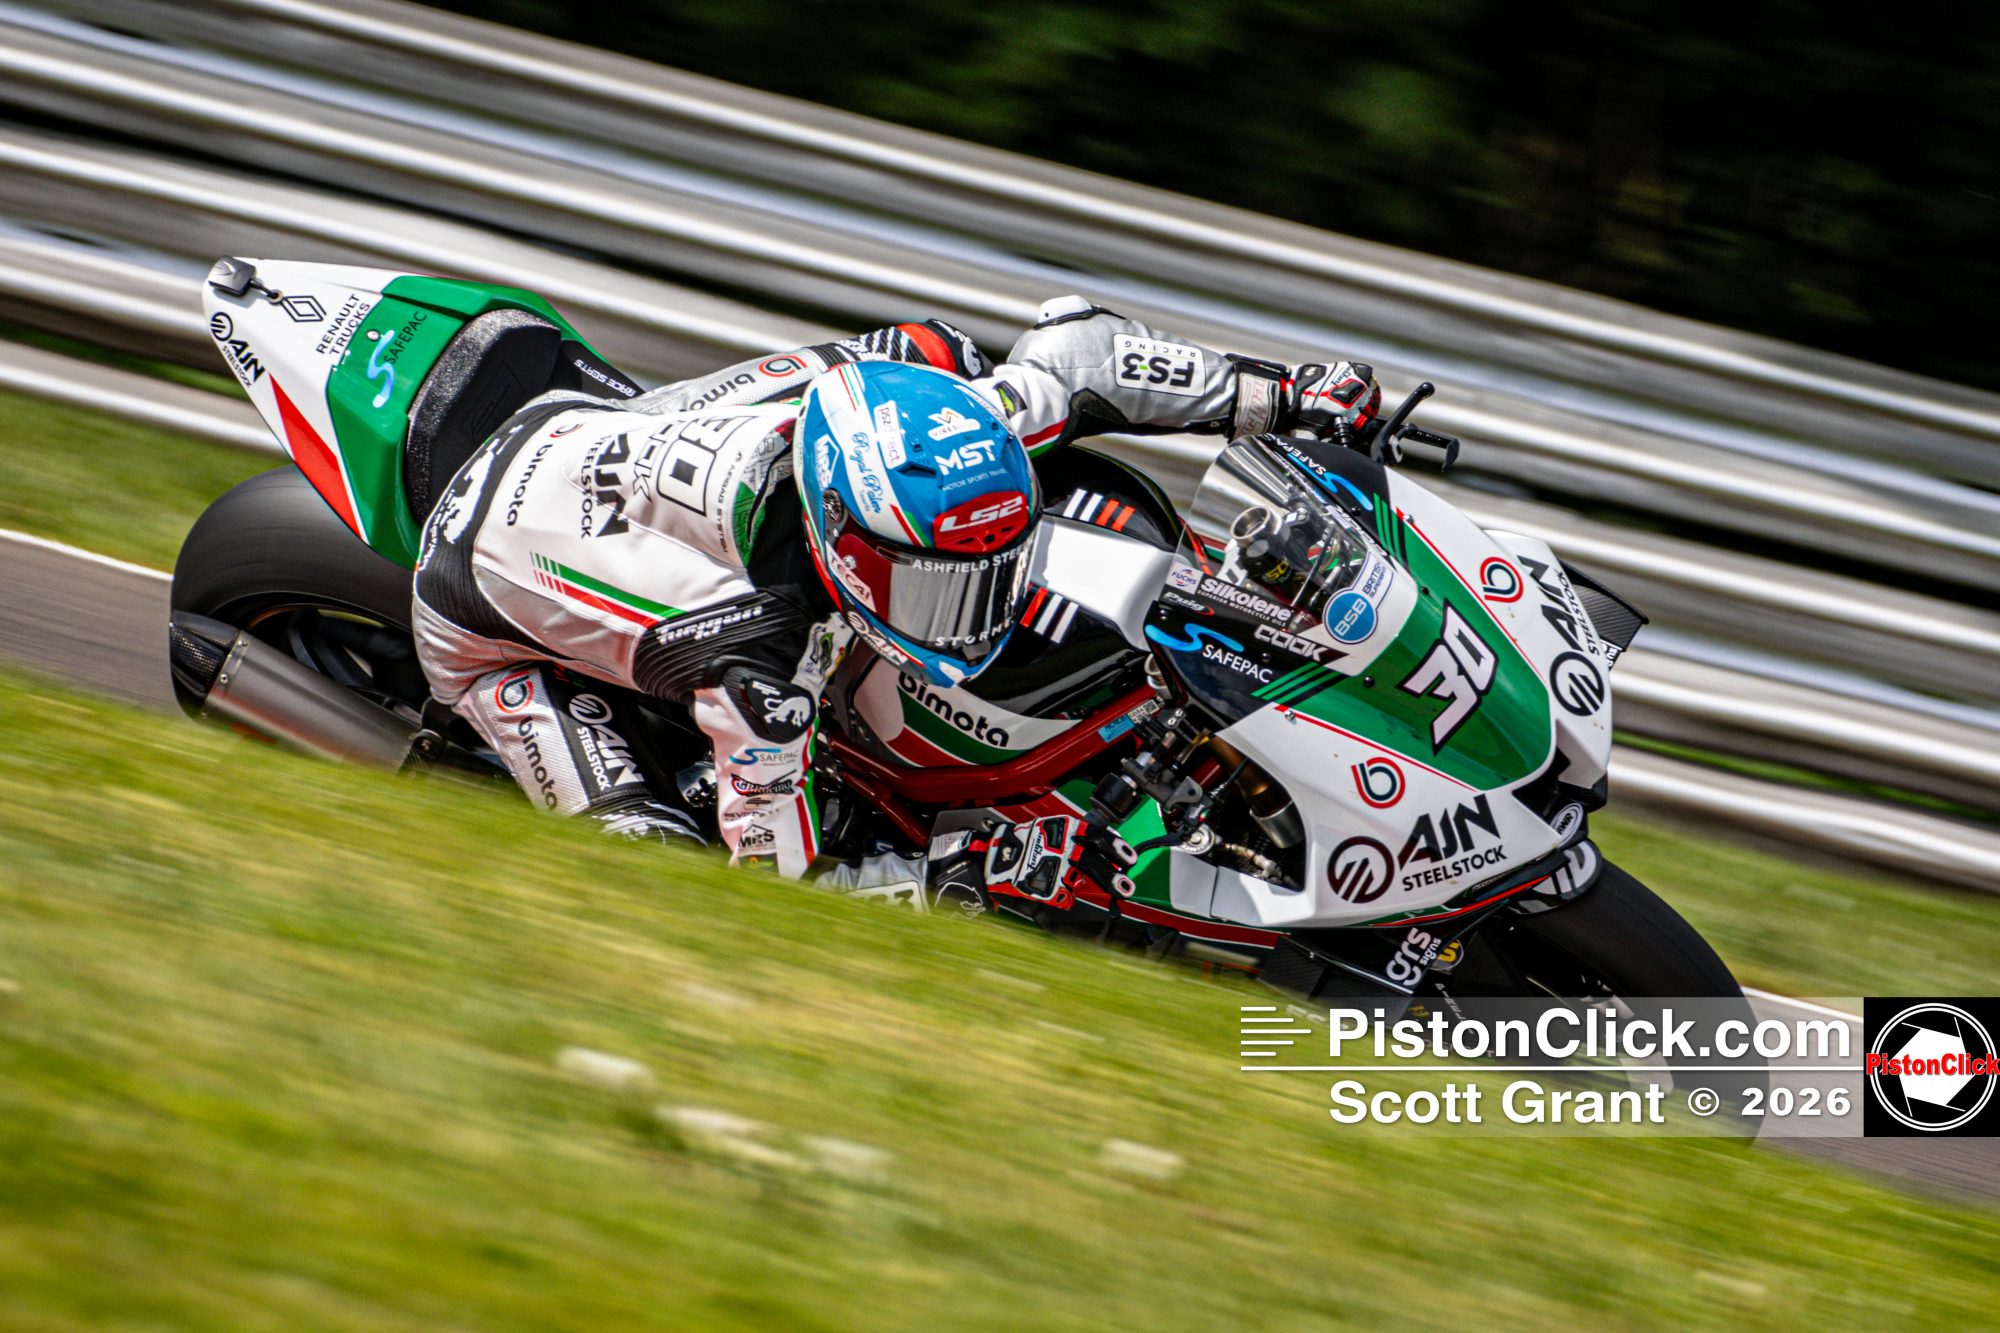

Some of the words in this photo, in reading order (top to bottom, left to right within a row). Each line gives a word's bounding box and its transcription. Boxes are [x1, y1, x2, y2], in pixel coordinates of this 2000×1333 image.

[315, 293, 360, 354] RENAULT
[329, 303, 370, 355] TRUCKS
[383, 311, 428, 365] SAFEPAC
[222, 345, 252, 388] STEELSTOCK
[228, 339, 266, 382] AJN
[1124, 340, 1196, 357] RACING
[574, 358, 608, 384] SEATS
[610, 376, 637, 398] RACE
[679, 373, 757, 412] bimo
[849, 432, 872, 473] Royal
[862, 474, 884, 514] Palm
[934, 440, 996, 476] MST
[1264, 433, 1327, 475] SAFEPAC
[506, 443, 553, 527] bimota
[596, 433, 631, 537] AJN
[942, 480, 966, 491] MOTOR
[968, 474, 989, 485] SPORTS
[716, 508, 729, 553] SYSTEM
[939, 496, 1023, 533] LS2
[912, 559, 989, 573] ASHFIELD
[992, 544, 1024, 567] STEE
[1171, 570, 1198, 585] FUCHS
[1198, 590, 1228, 605] SUPERIOR
[1229, 602, 1270, 621] MOTORCYCLE
[1271, 618, 1287, 628] OILS
[1200, 578, 1291, 621] Silkolene
[1334, 597, 1368, 637] BSB
[1517, 555, 1585, 652] AJN
[1553, 568, 1600, 656] STEELSTOCK
[1203, 643, 1273, 684] SAFEPAC
[1254, 623, 1326, 662] COOK
[1395, 597, 1499, 756] 30
[898, 671, 1010, 748] bimota
[517, 717, 559, 813] bimota
[577, 726, 611, 791] STEELSTOCK
[592, 724, 645, 787] AJN
[1397, 793, 1501, 872] AJN
[1402, 845, 1507, 891] STEELSTOCK
[1386, 927, 1431, 986] grs
[1420, 937, 1442, 965] signs
[1435, 983, 1475, 1034] PIRELI
